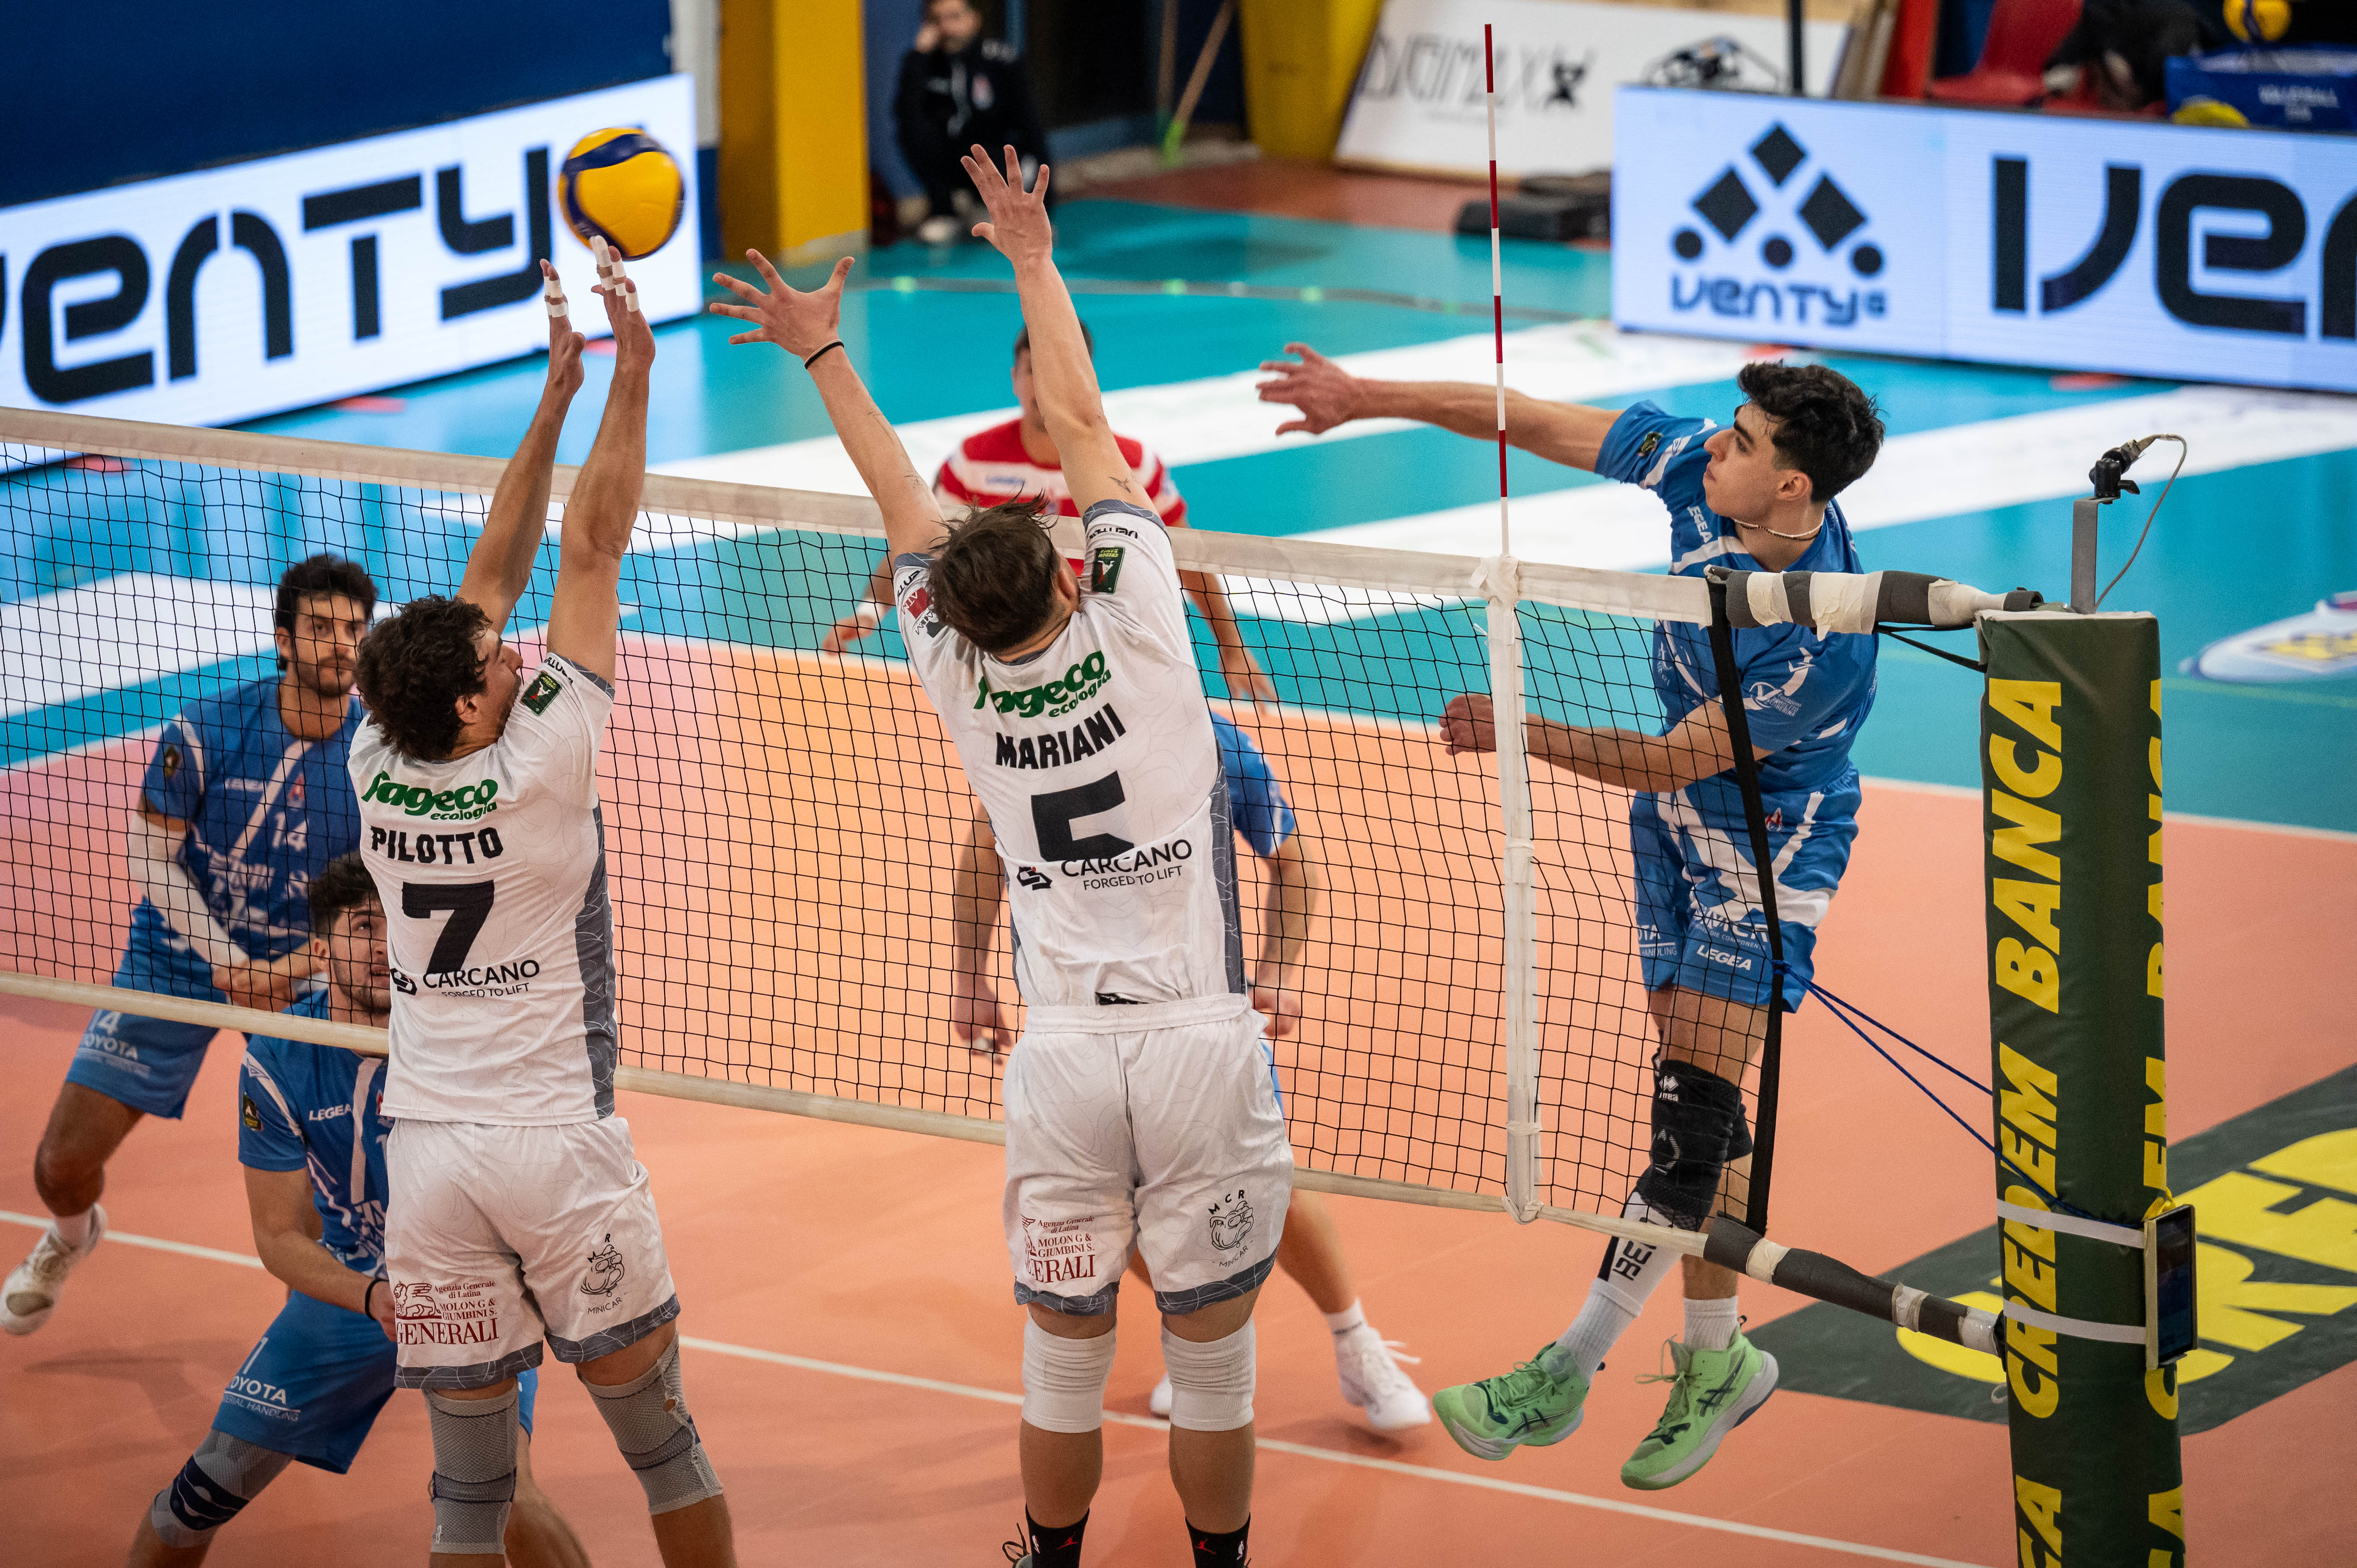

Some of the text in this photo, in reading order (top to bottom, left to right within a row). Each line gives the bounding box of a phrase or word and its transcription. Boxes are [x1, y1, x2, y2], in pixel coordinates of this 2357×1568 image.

[1687, 505, 1713, 543] EGEA
[1048, 667, 1112, 718] ecologia
[995, 703, 1126, 770] MARIANI
[361, 770, 498, 816] Sageco
[431, 802, 497, 821] ecologia
[370, 825, 504, 865] PILOTTO
[1061, 839, 1192, 877] CARCANO
[1989, 677, 2062, 1014] BANCA
[1084, 866, 1183, 891] FORGED TO LIFT
[402, 880, 495, 974] 7
[1696, 944, 1752, 971] LEGEA
[423, 959, 540, 989] CARCANO
[486, 988, 504, 997] TO
[506, 982, 530, 995] LIFT
[82, 1032, 139, 1060] OYOTA
[309, 1103, 354, 1121] LEGEA
[1037, 1216, 1094, 1228] Agenzia Generale
[1999, 1042, 2059, 1419] CREDEM
[1038, 1233, 1092, 1247] MOLON G &
[1038, 1243, 1095, 1258] GIUMBINI S.
[1219, 1245, 1248, 1267] MINICAR
[434, 1281, 496, 1294] Agenzia Generale
[440, 1297, 496, 1311] MOLON G &
[443, 1307, 497, 1320] GIUMBINI S.
[588, 1297, 622, 1314] MINICAR
[396, 1318, 500, 1345] GENERALI
[228, 1375, 287, 1405] OYOTA
[246, 1402, 298, 1422] HANDLING
